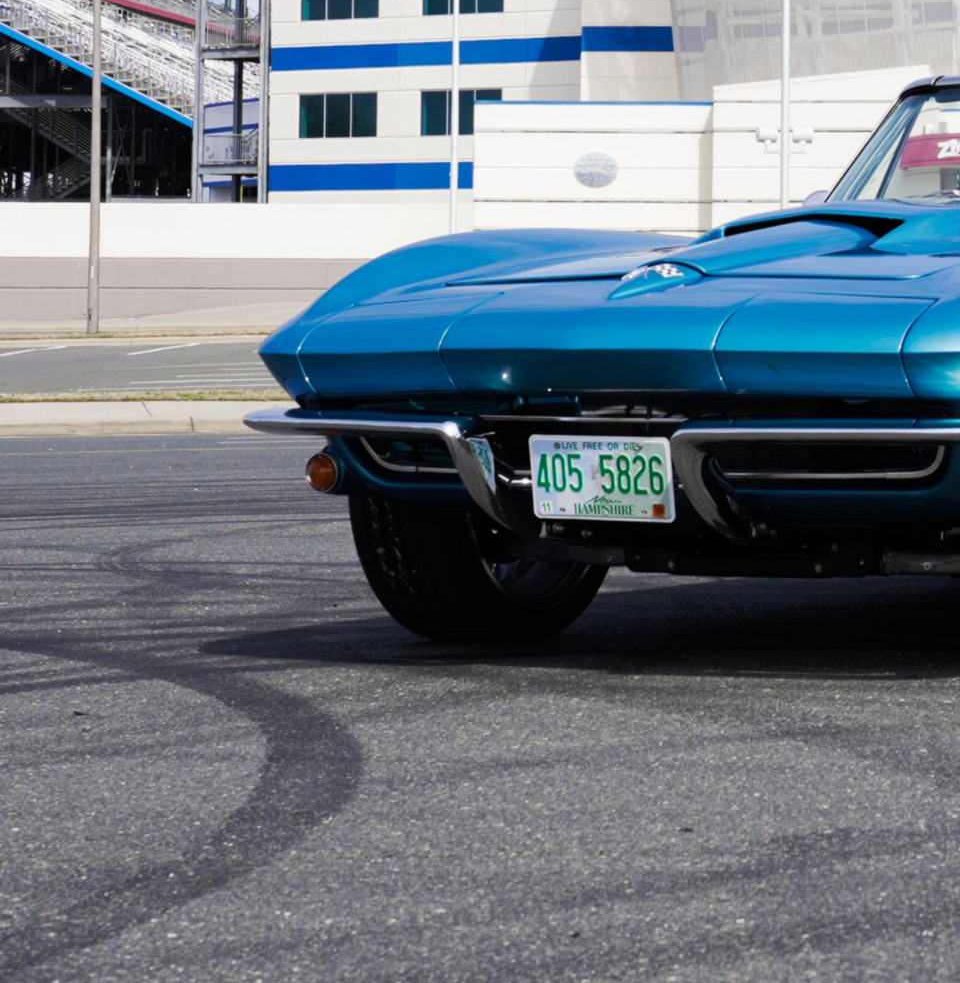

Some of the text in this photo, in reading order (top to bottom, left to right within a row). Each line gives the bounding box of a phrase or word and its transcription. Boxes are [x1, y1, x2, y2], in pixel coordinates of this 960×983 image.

[562, 442, 638, 451] LIVE FREE OR DIE
[537, 453, 665, 495] 405 5826
[585, 495, 622, 504] New
[574, 503, 635, 516] HAMPSHIRE
